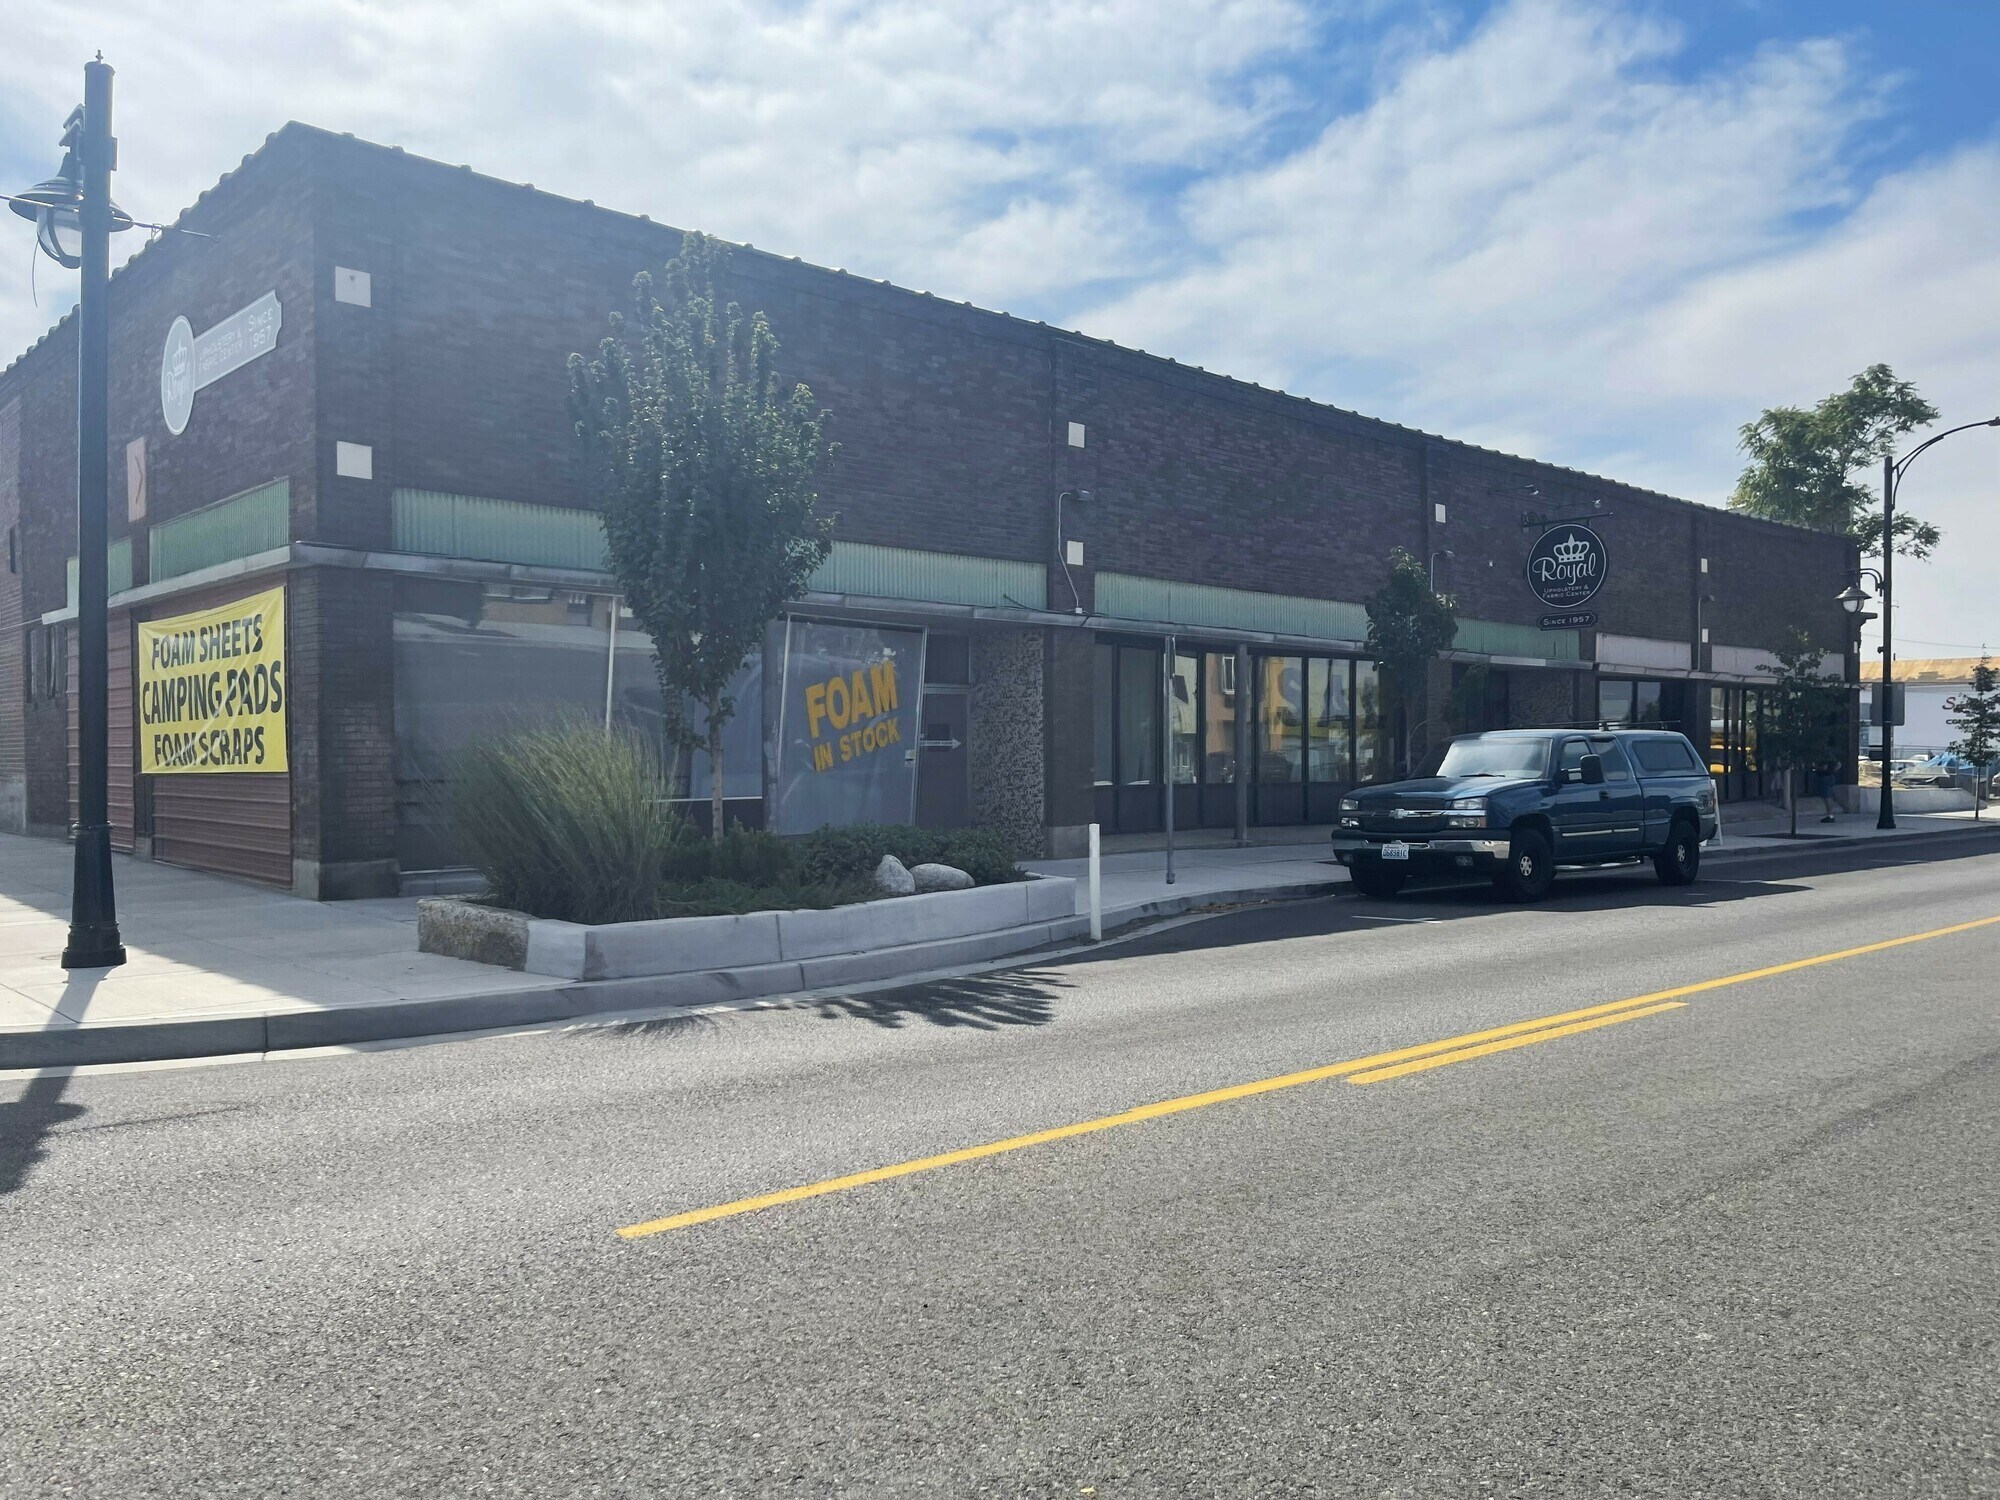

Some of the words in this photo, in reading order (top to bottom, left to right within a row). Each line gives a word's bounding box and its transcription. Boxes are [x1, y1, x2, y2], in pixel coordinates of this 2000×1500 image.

[249, 325, 272, 350] 1957
[1532, 552, 1596, 586] Royal
[152, 630, 195, 670] FOAM
[199, 614, 263, 662] SHEETS
[1543, 618, 1566, 626] SINCE
[1569, 616, 1590, 624] 1957
[142, 671, 222, 725] CAMPING
[225, 660, 283, 717] PADS
[805, 659, 898, 738] FOAM
[154, 732, 197, 767] FOAM
[199, 726, 265, 766] SCRAPS
[813, 742, 834, 772] IN
[839, 716, 900, 761] STOCK
